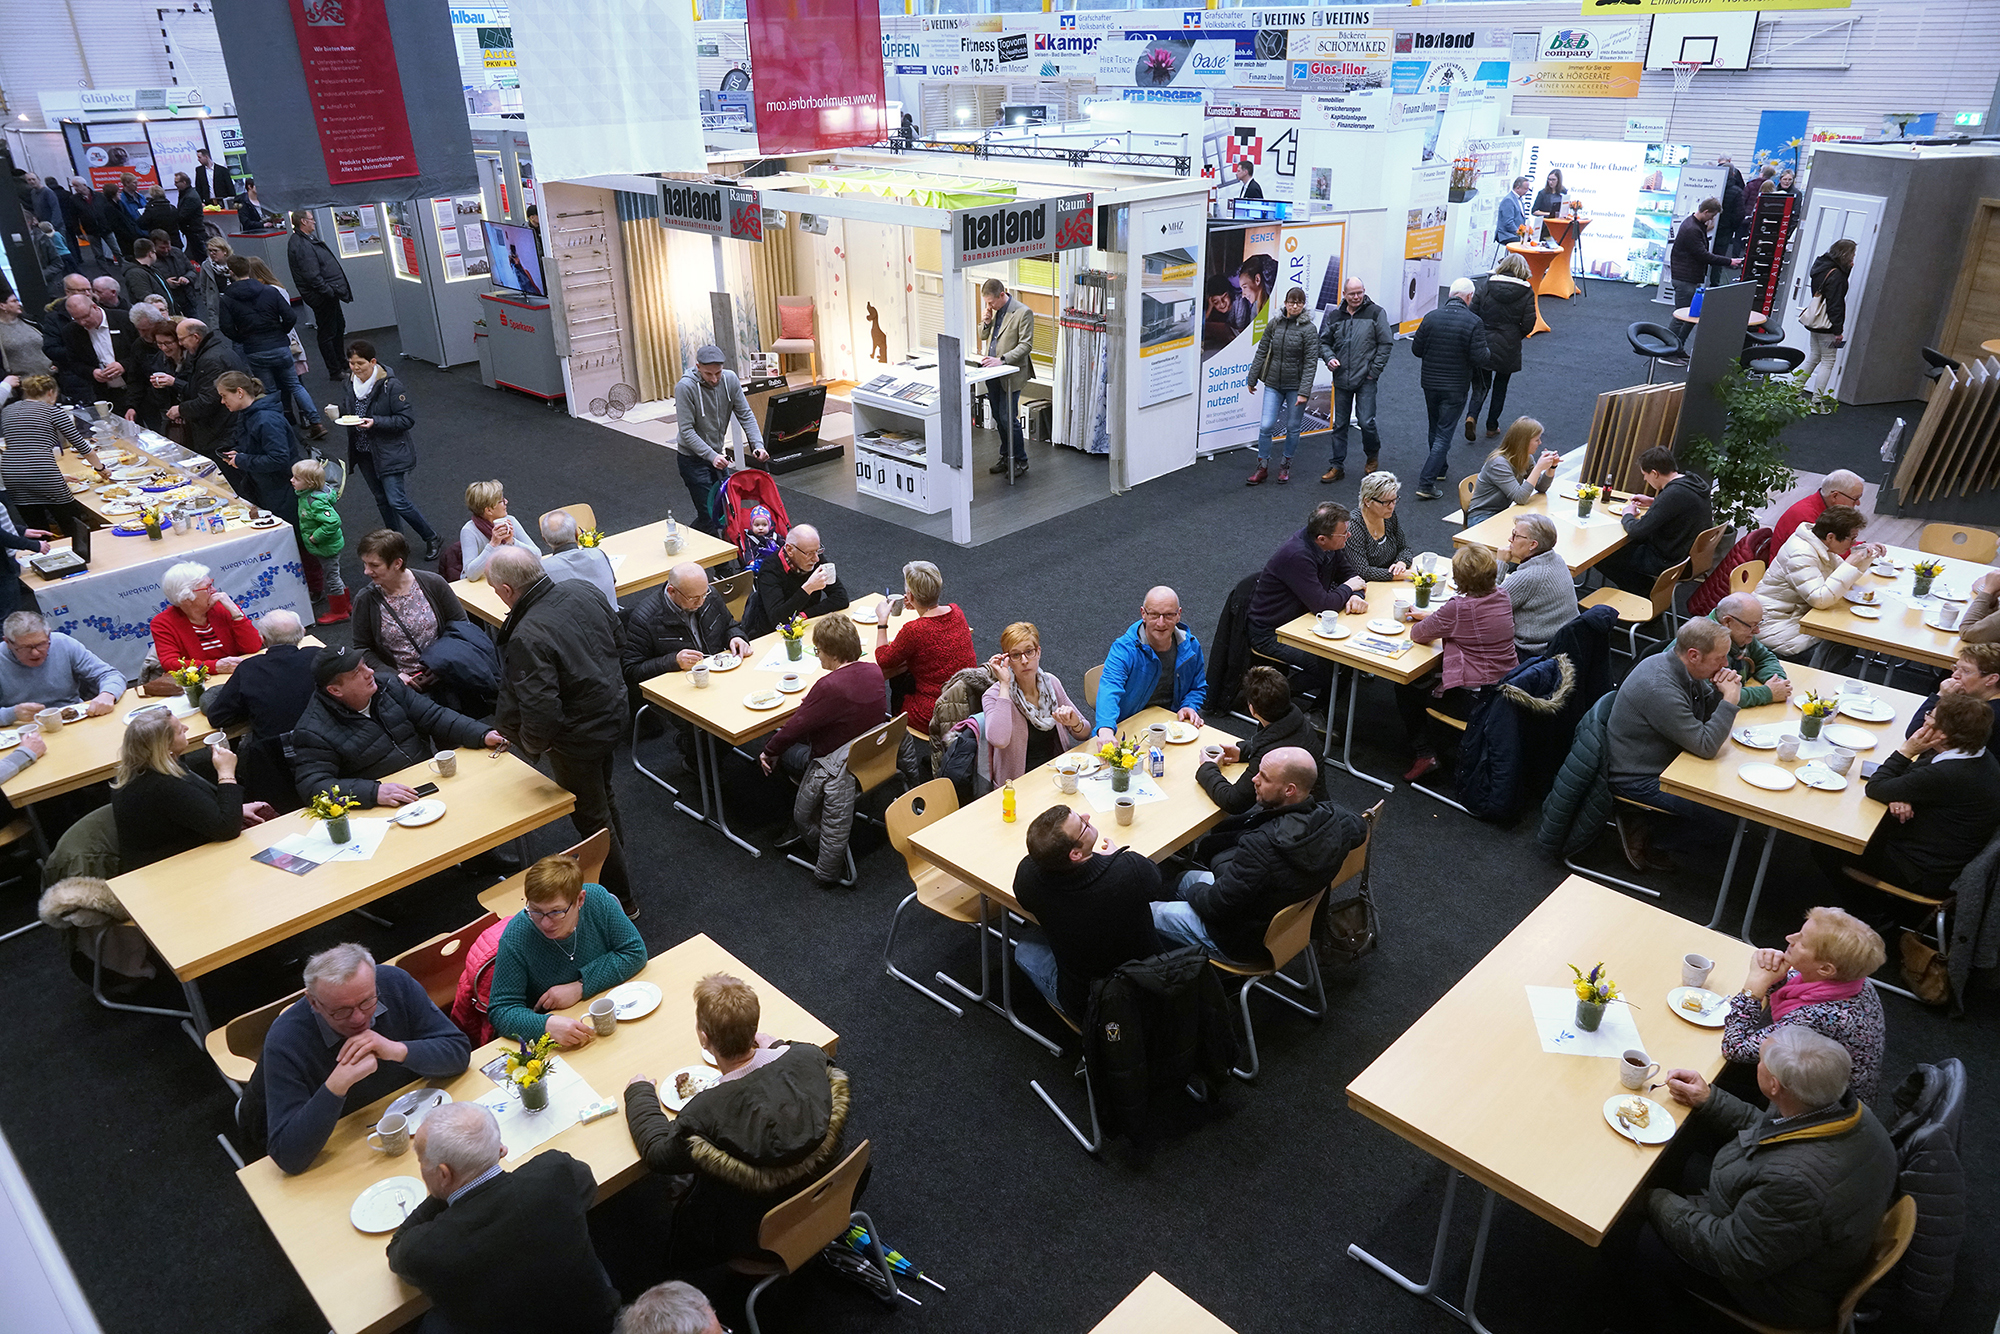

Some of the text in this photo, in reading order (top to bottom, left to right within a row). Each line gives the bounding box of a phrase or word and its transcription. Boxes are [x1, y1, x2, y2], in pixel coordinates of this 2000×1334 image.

[1078, 14, 1112, 22] Grafschafter
[1204, 11, 1243, 20] Grafschafter
[1264, 12, 1306, 26] VELTINS
[1325, 11, 1369, 25] VELTINS
[931, 19, 959, 30] VELTINS
[1079, 22, 1105, 30] Volksbank
[1204, 20, 1236, 28] Volksbank
[1338, 31, 1367, 39] Bäckerei
[1415, 32, 1475, 49] harland
[961, 37, 996, 52] Fitness
[999, 37, 1027, 50] Topvorm
[1317, 40, 1387, 53] SCHOEMAKER
[1550, 34, 1590, 50] b&b
[1099, 54, 1136, 64] HIER TEICH-
[1544, 49, 1594, 59] company
[971, 58, 994, 75] 18,75
[994, 65, 999, 73] €
[1000, 64, 1008, 72] im
[1192, 52, 1227, 69] Oase
[932, 65, 953, 76] VGH
[1099, 66, 1131, 74] BERATUNG
[1536, 70, 1611, 80] OPTIK & HÖRGERÄTE
[1268, 73, 1285, 81] Union
[1123, 89, 1203, 104] PTB BORGERS
[1458, 87, 1485, 97] Finanz Union
[81, 93, 131, 105] Glüpker
[1239, 108, 1262, 117] Fenster
[1267, 108, 1284, 118] Türen
[1323, 105, 1362, 113] Versicherungen
[1402, 102, 1436, 114] Finanz Union
[1330, 113, 1367, 122] Kapitalanlagen
[1336, 122, 1375, 130] Finanzierungen
[1524, 146, 1539, 183] Union
[1549, 160, 1638, 172] Nutzen Sie Ihre Chance!
[662, 184, 722, 223] harland
[1590, 209, 1625, 218] Immobilien
[664, 216, 724, 232] Raumausstattermeister
[962, 204, 1046, 252] harland
[1168, 220, 1184, 231] MHZ
[1595, 231, 1625, 240] Standorte
[1776, 214, 1791, 248] STAHL
[1250, 232, 1275, 244] SENEC
[962, 241, 1047, 262] Raumausstattermeister
[1770, 256, 1781, 277] AUS
[508, 319, 536, 334] Sparkasse
[1207, 380, 1229, 394] auch
[1206, 393, 1240, 408] nutzen!
[220, 556, 259, 572] Volksbank
[117, 583, 161, 599] Volksbank
